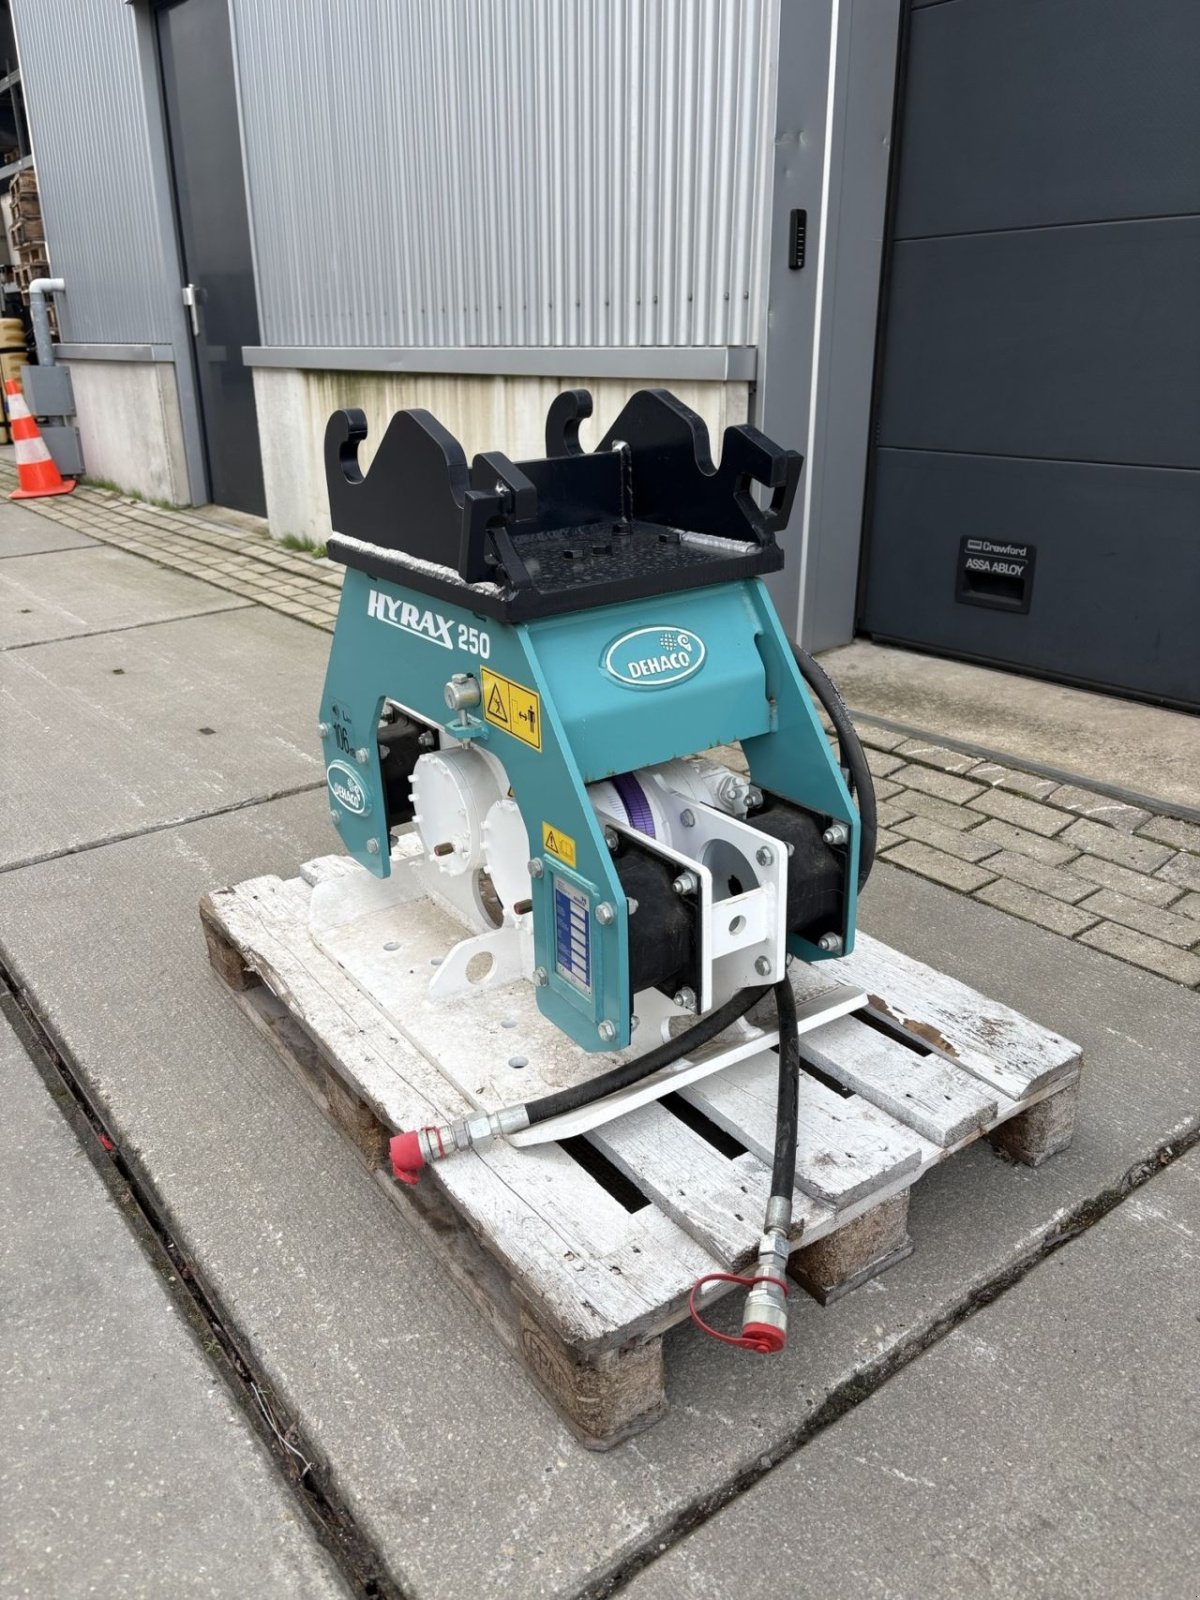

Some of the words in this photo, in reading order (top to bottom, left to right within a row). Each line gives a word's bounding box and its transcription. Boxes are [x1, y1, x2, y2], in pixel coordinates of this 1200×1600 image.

[965, 558, 991, 571] ASSA
[991, 562, 1024, 576] ABLOY
[367, 589, 455, 650] HYRAX
[458, 623, 490, 660] 250
[627, 651, 690, 679] DEHACO
